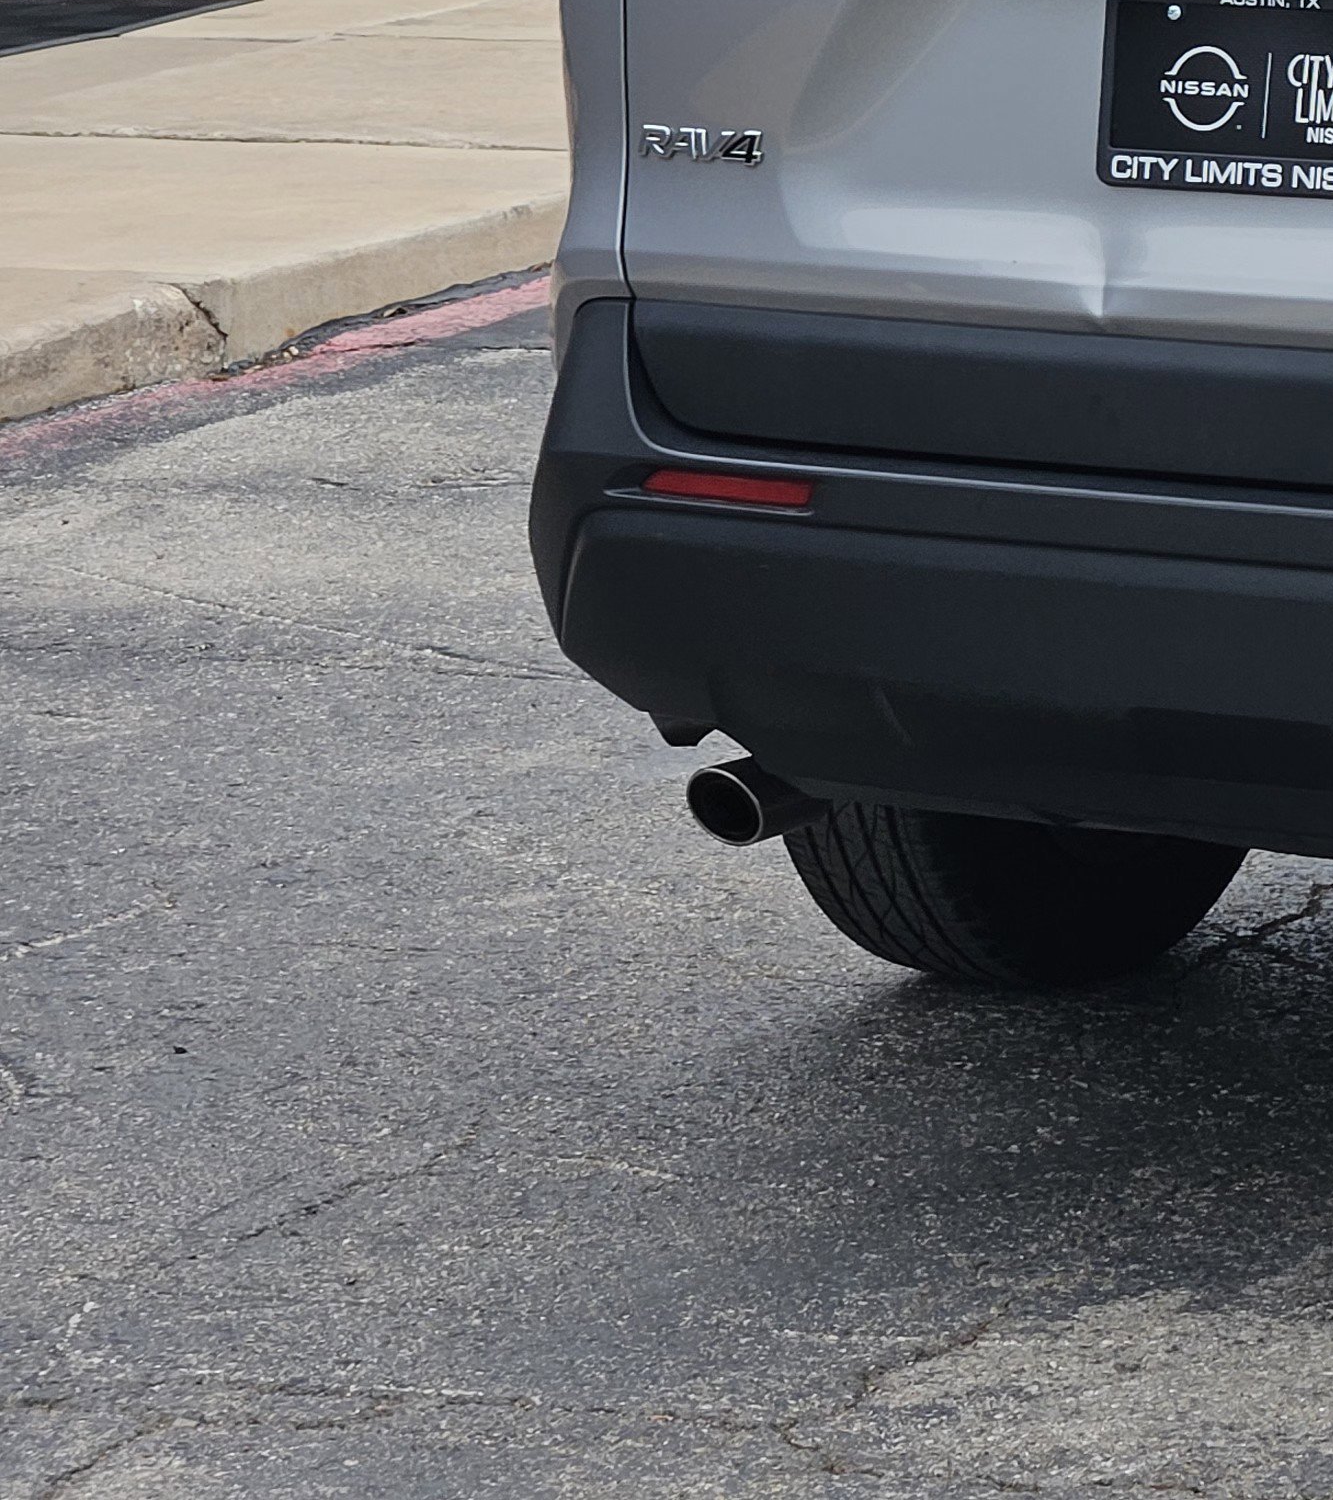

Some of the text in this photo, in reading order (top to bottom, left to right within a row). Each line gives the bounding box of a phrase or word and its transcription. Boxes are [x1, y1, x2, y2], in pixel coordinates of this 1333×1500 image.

[1160, 79, 1249, 98] NISSAN
[639, 124, 763, 167] RAV4
[1111, 154, 1178, 181] CITY
[1184, 159, 1283, 188] LIMITS
